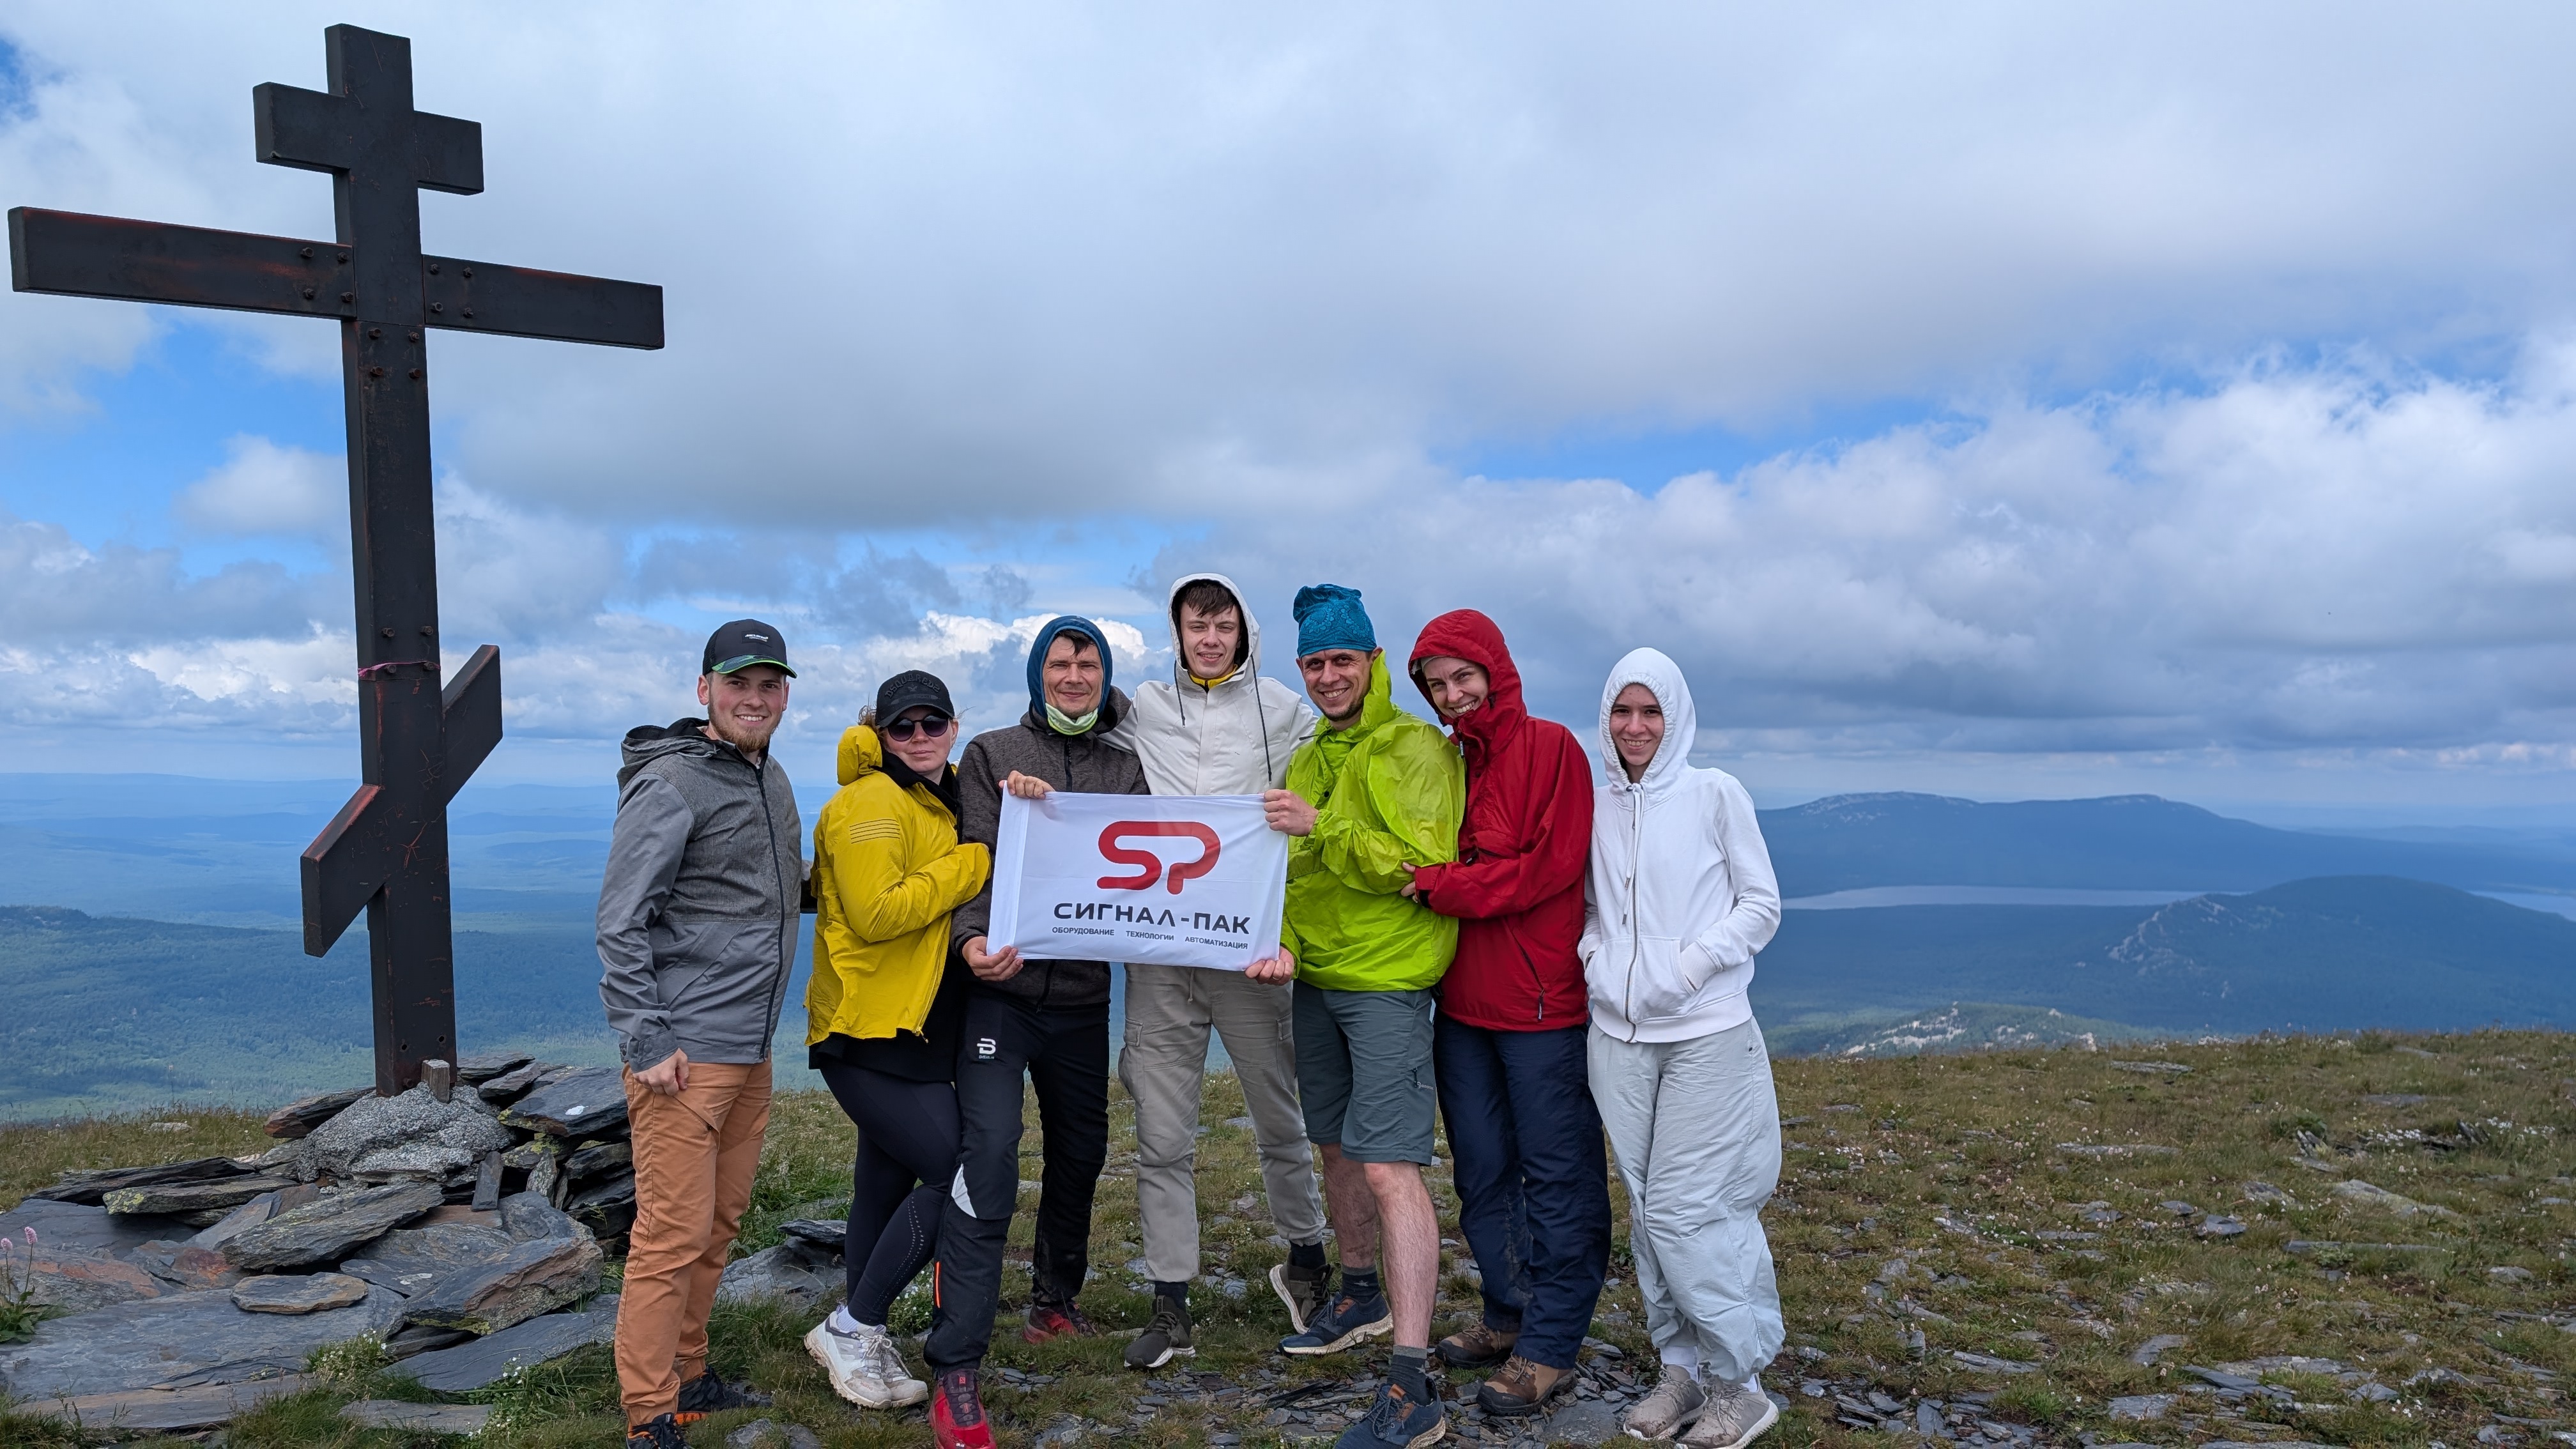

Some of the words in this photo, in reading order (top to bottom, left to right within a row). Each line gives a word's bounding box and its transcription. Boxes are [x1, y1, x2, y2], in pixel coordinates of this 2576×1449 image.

[1096, 820, 1221, 895] SP
[1054, 903, 1250, 934] СИГНАЛ-ПАК
[1052, 926, 1116, 936] ОБОРУДОВАНИЕ
[1126, 930, 1174, 941] ТЕХНОЛОГИИ
[1184, 936, 1248, 950] АВТОМАТИЗАЦИЯ
